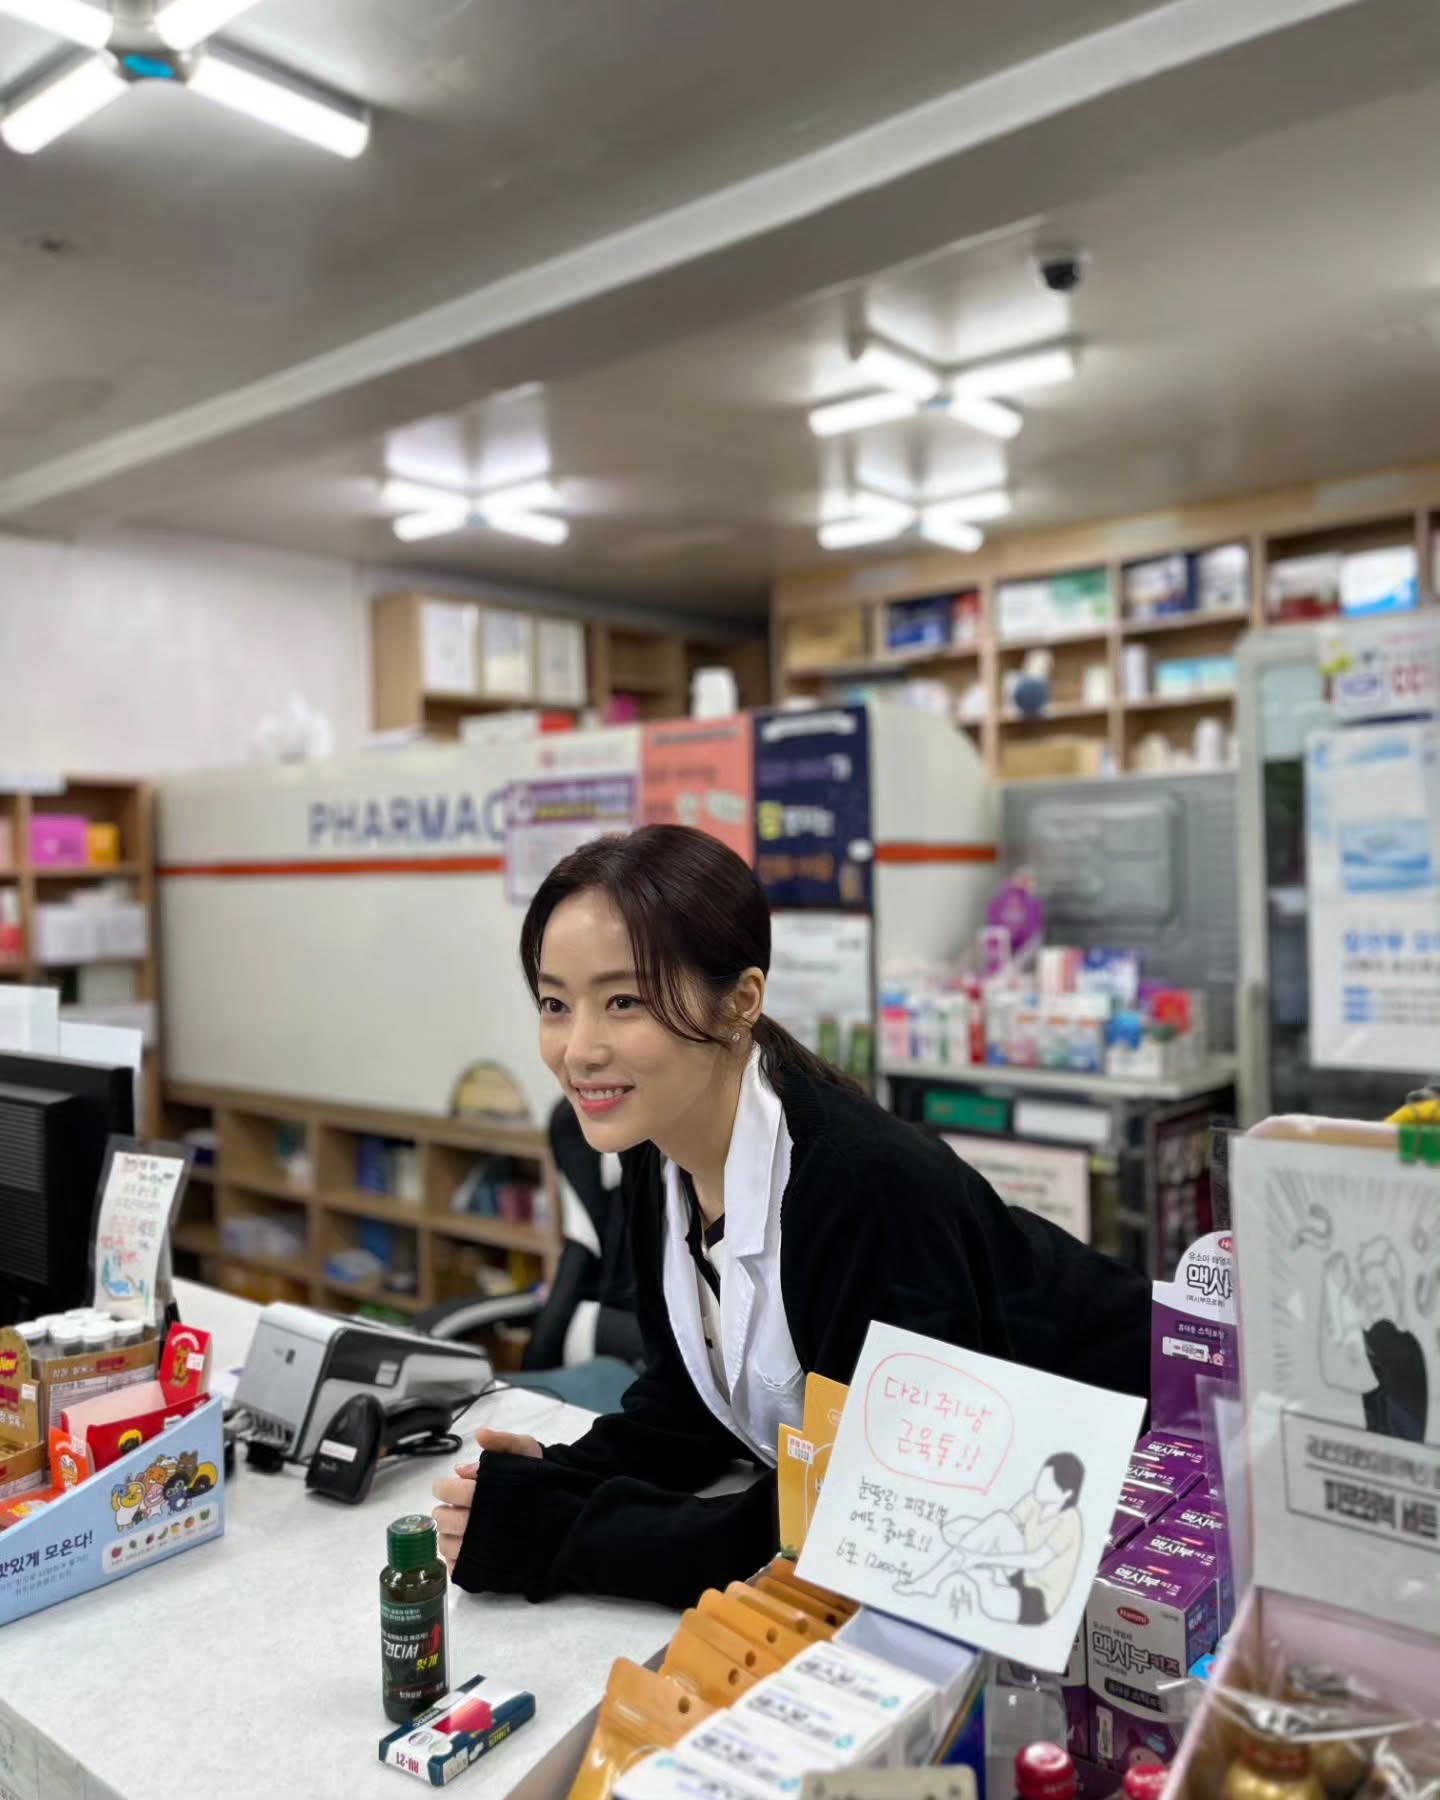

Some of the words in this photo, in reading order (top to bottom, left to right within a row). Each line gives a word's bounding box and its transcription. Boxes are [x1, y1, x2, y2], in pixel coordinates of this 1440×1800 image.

[1187, 1263, 1233, 1300] 맥시
[883, 1376, 928, 1407] 다리
[849, 1508, 876, 1531] 에도
